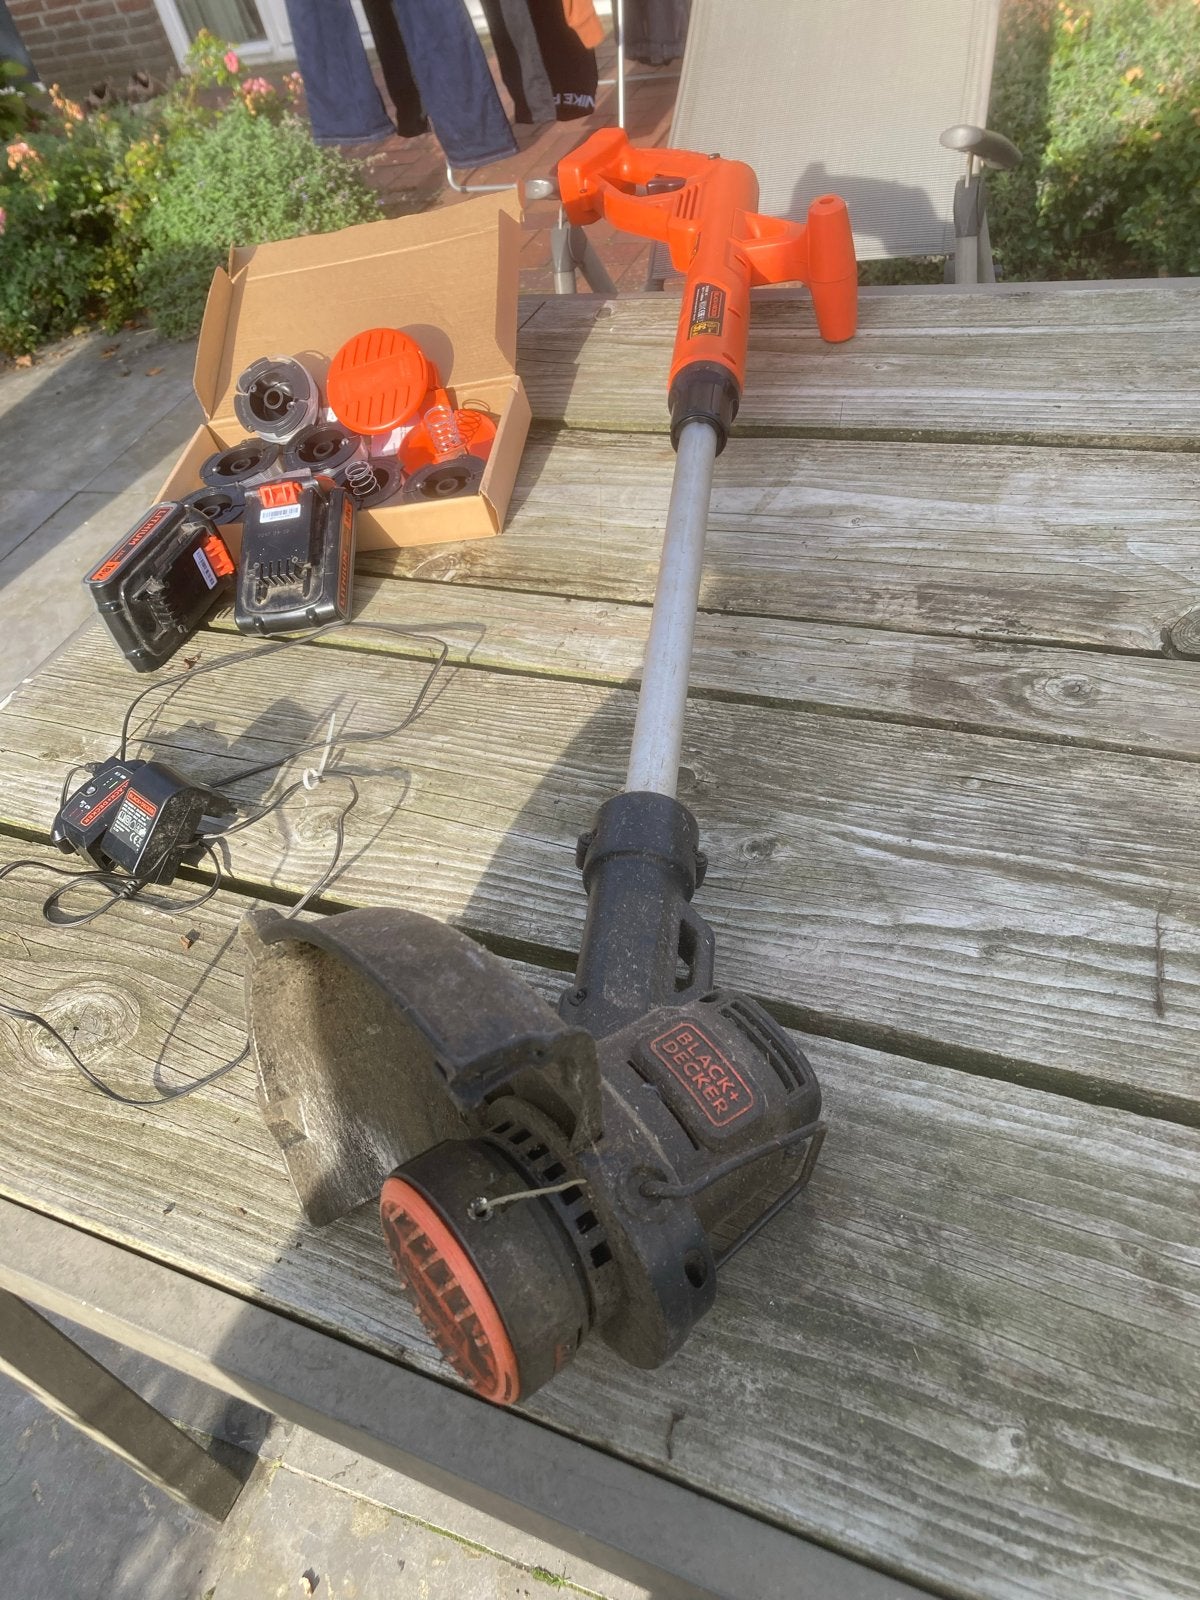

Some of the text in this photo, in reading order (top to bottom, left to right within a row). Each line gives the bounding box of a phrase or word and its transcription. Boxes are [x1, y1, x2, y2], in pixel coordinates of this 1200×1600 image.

[563, 93, 595, 107] NIKE
[128, 509, 168, 546] LITHIUM
[662, 1041, 728, 1115] DECKER
